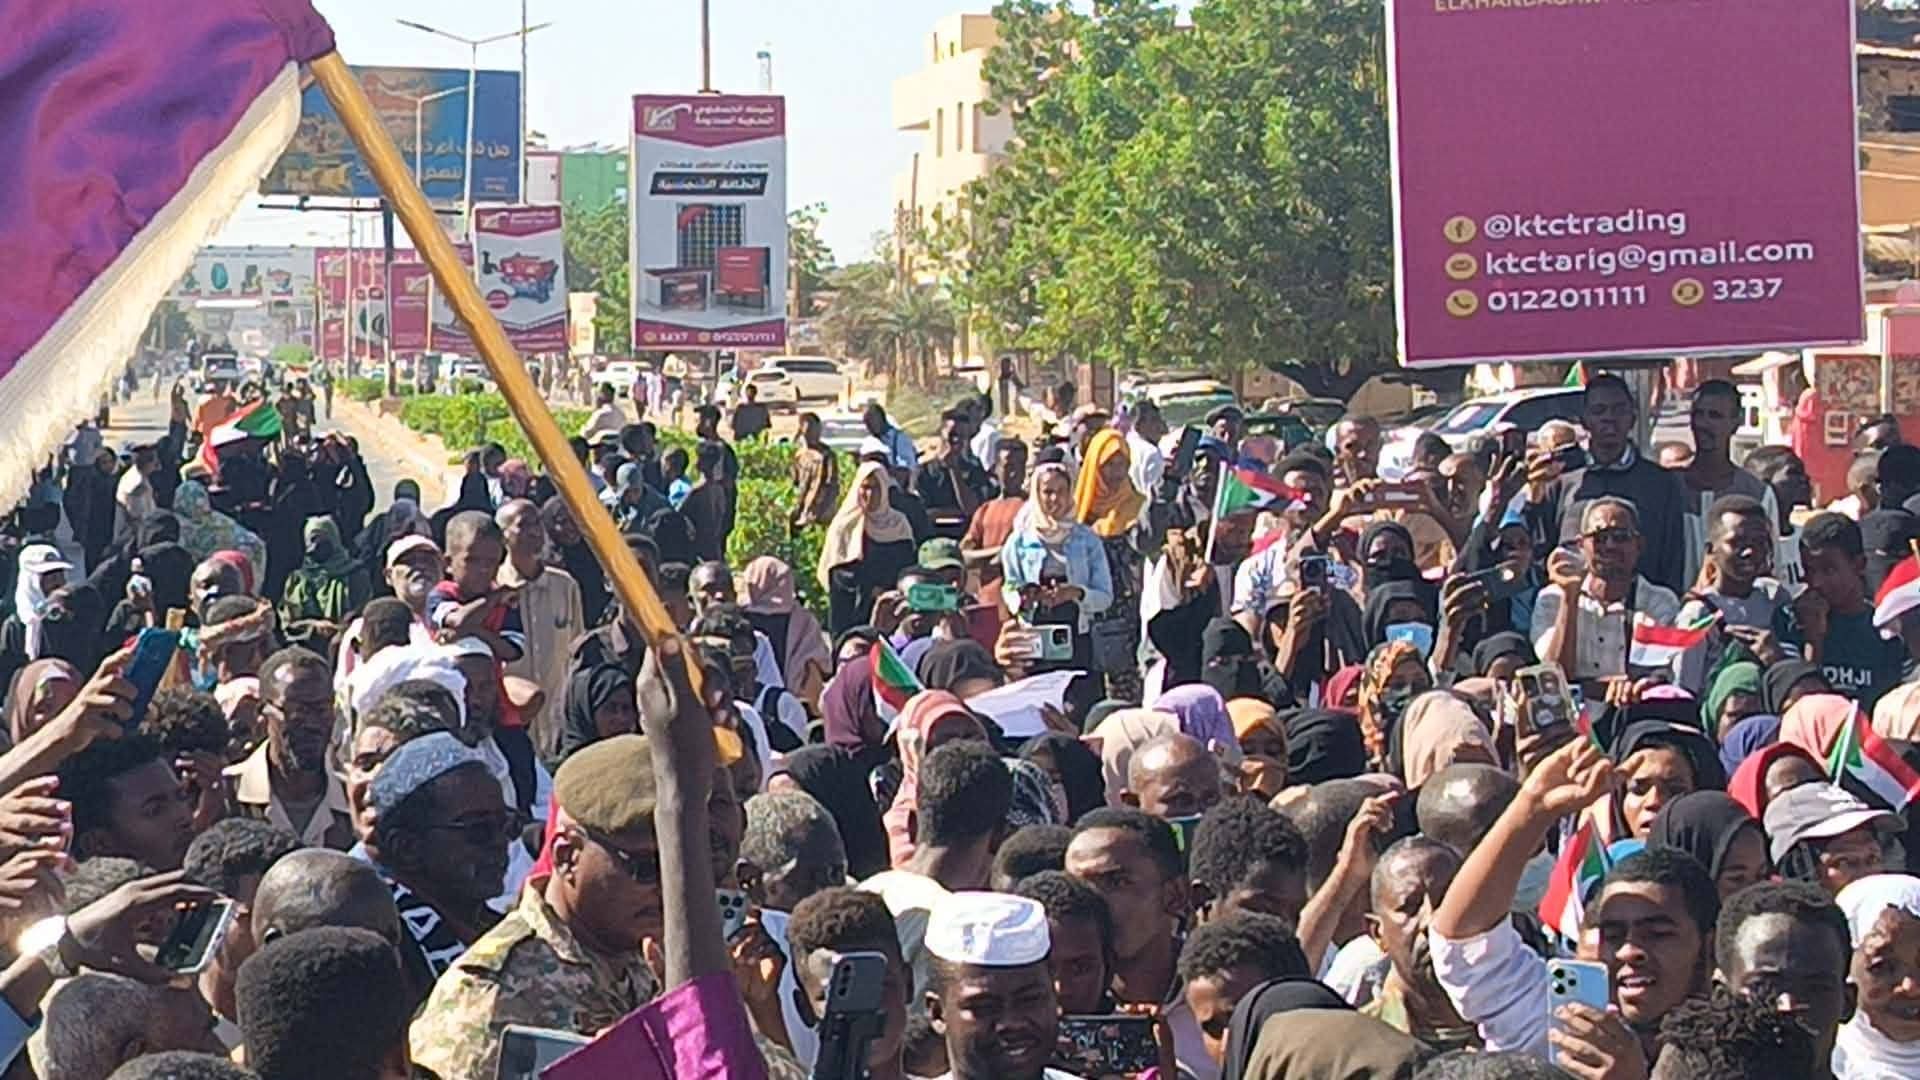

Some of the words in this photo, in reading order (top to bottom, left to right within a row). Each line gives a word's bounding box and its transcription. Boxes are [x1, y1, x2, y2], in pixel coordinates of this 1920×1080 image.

[1484, 208, 1687, 240] @ktctrading
[1485, 240, 1814, 276] ktctarig@gmail.com
[1487, 285, 1647, 312] 0122011111
[1712, 278, 1783, 301] 3237
